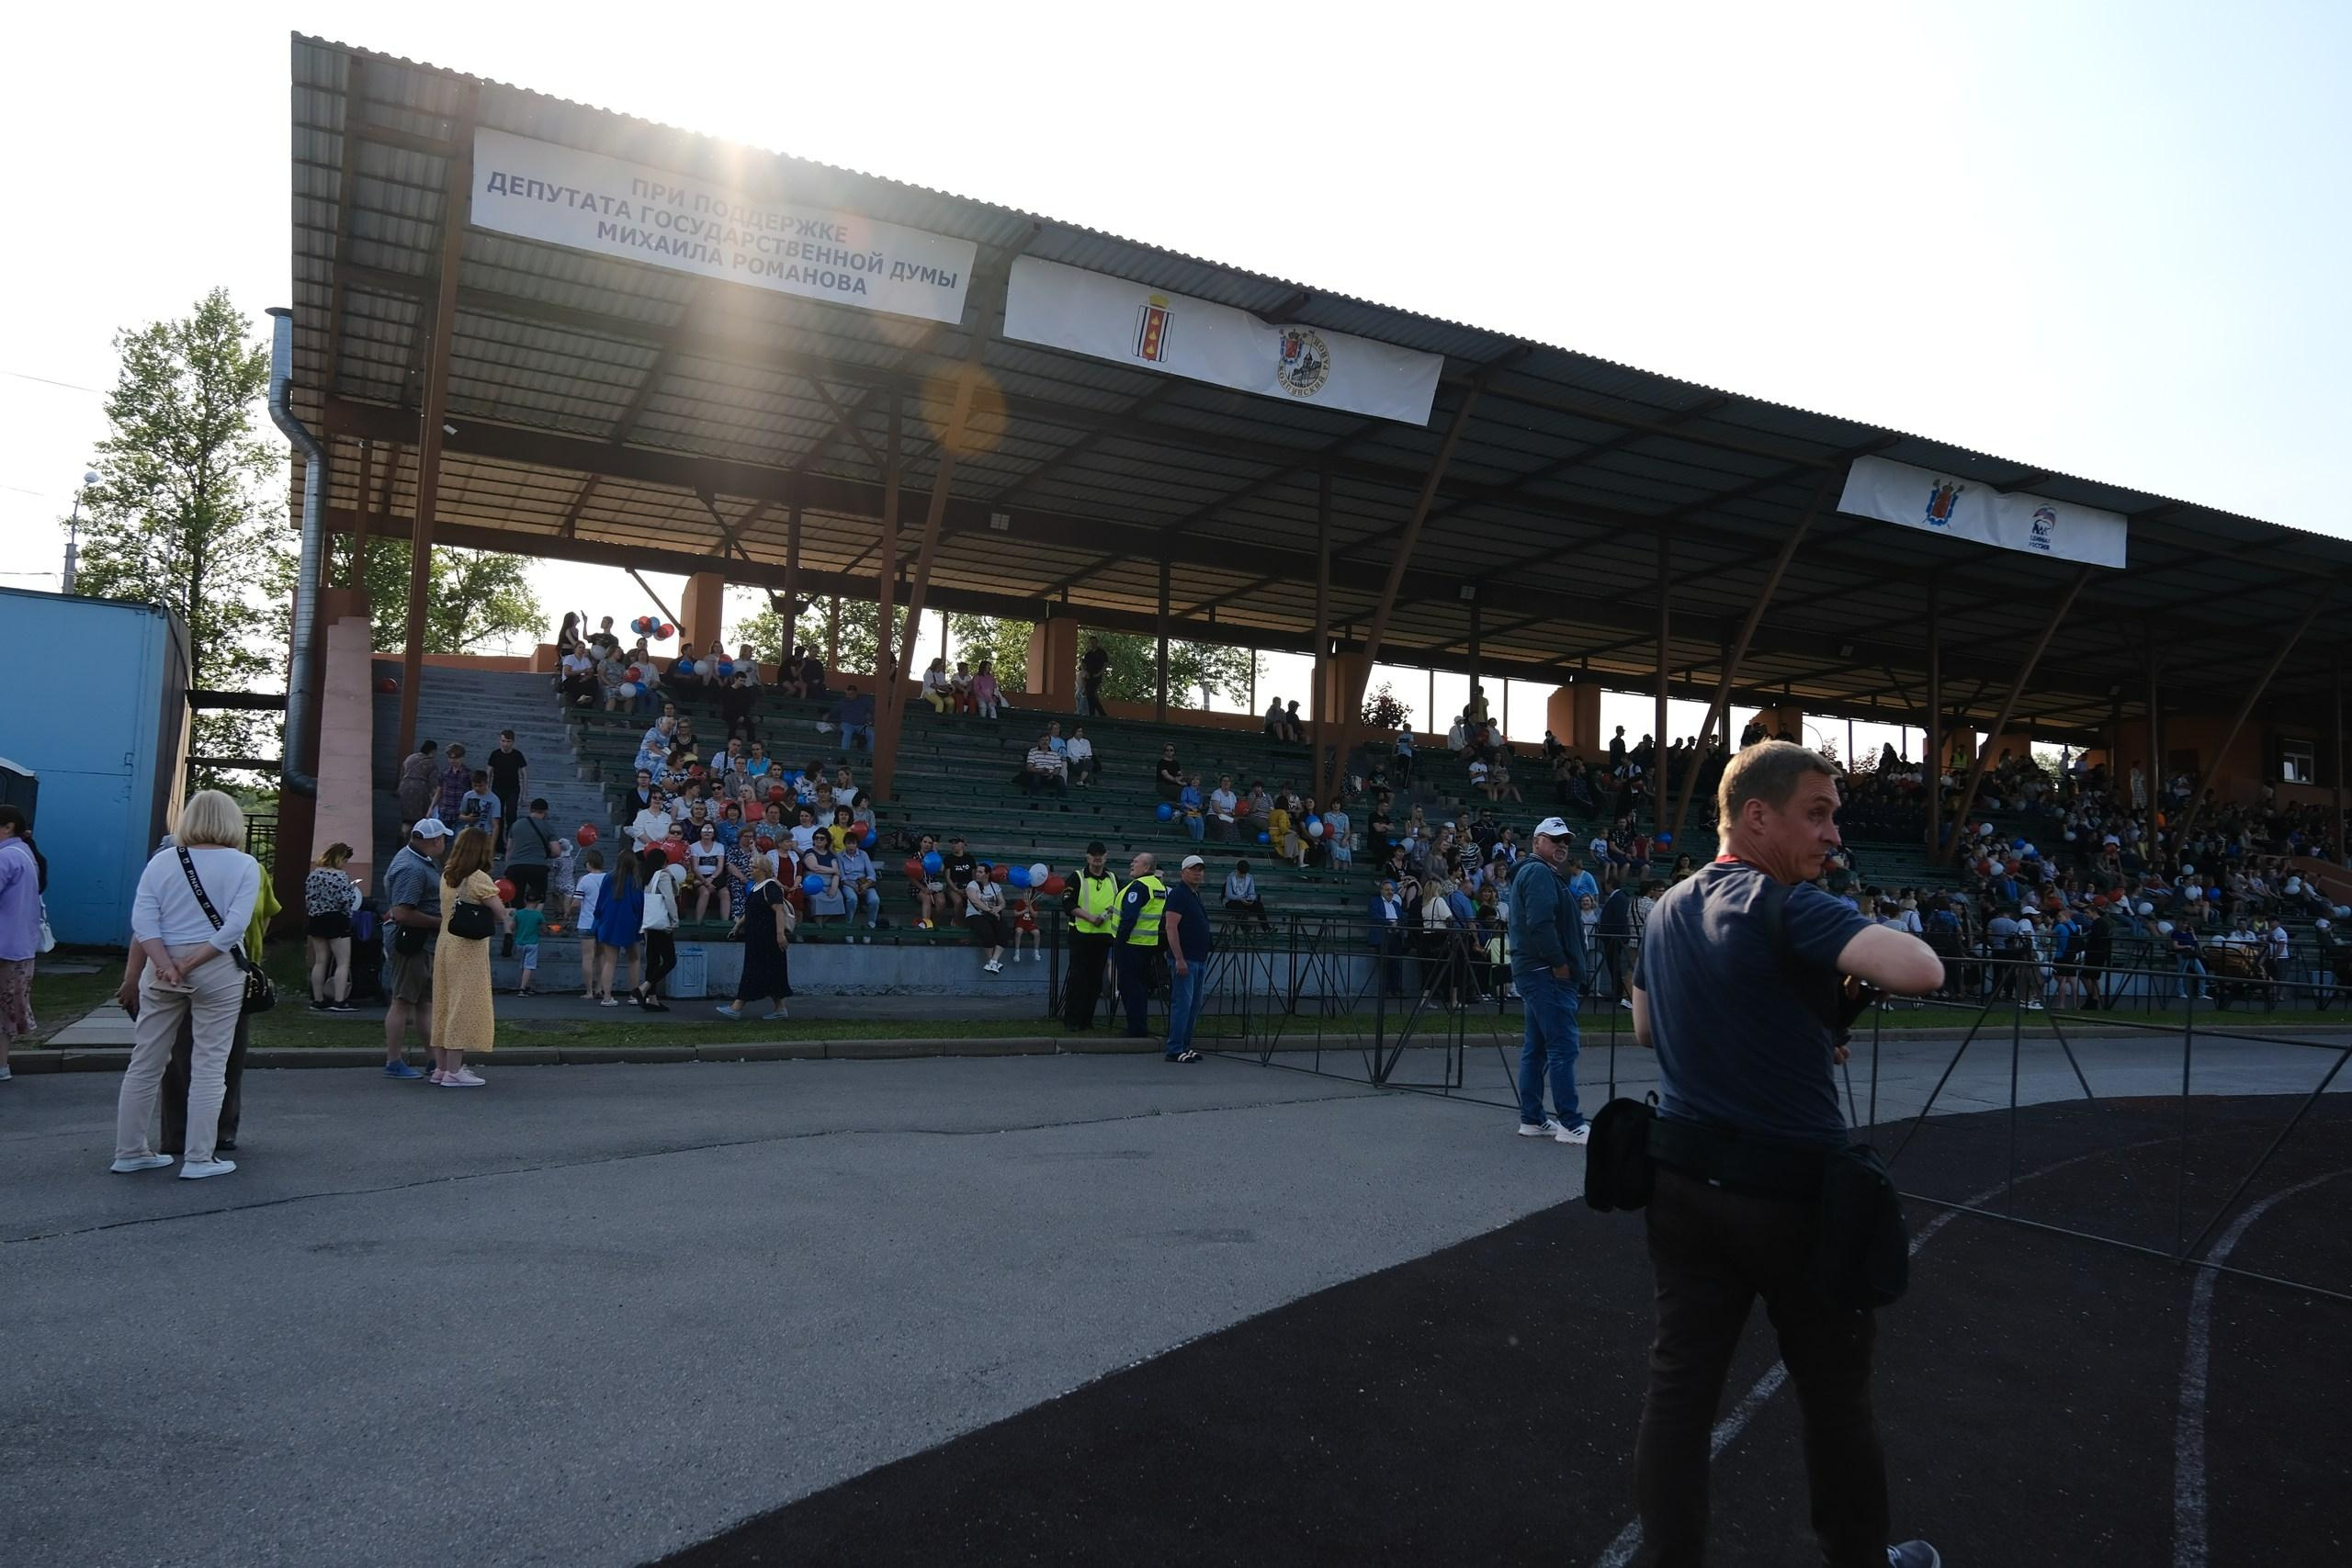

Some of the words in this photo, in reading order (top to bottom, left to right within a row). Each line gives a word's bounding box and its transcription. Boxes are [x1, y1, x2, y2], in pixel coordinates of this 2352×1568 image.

[487, 172, 631, 219] ДЕПУТАТА
[641, 206, 884, 274] ГОСУДАРСТВЕННОЙ
[889, 262, 957, 288] ДУМЫ
[632, 177, 684, 208] ПРИ
[695, 194, 848, 243] ПОДДЕРЖКЕ
[597, 221, 723, 265] МИХАИЛА
[732, 253, 867, 295] РОМАНОВА
[187, 870, 203, 897] PINKO
